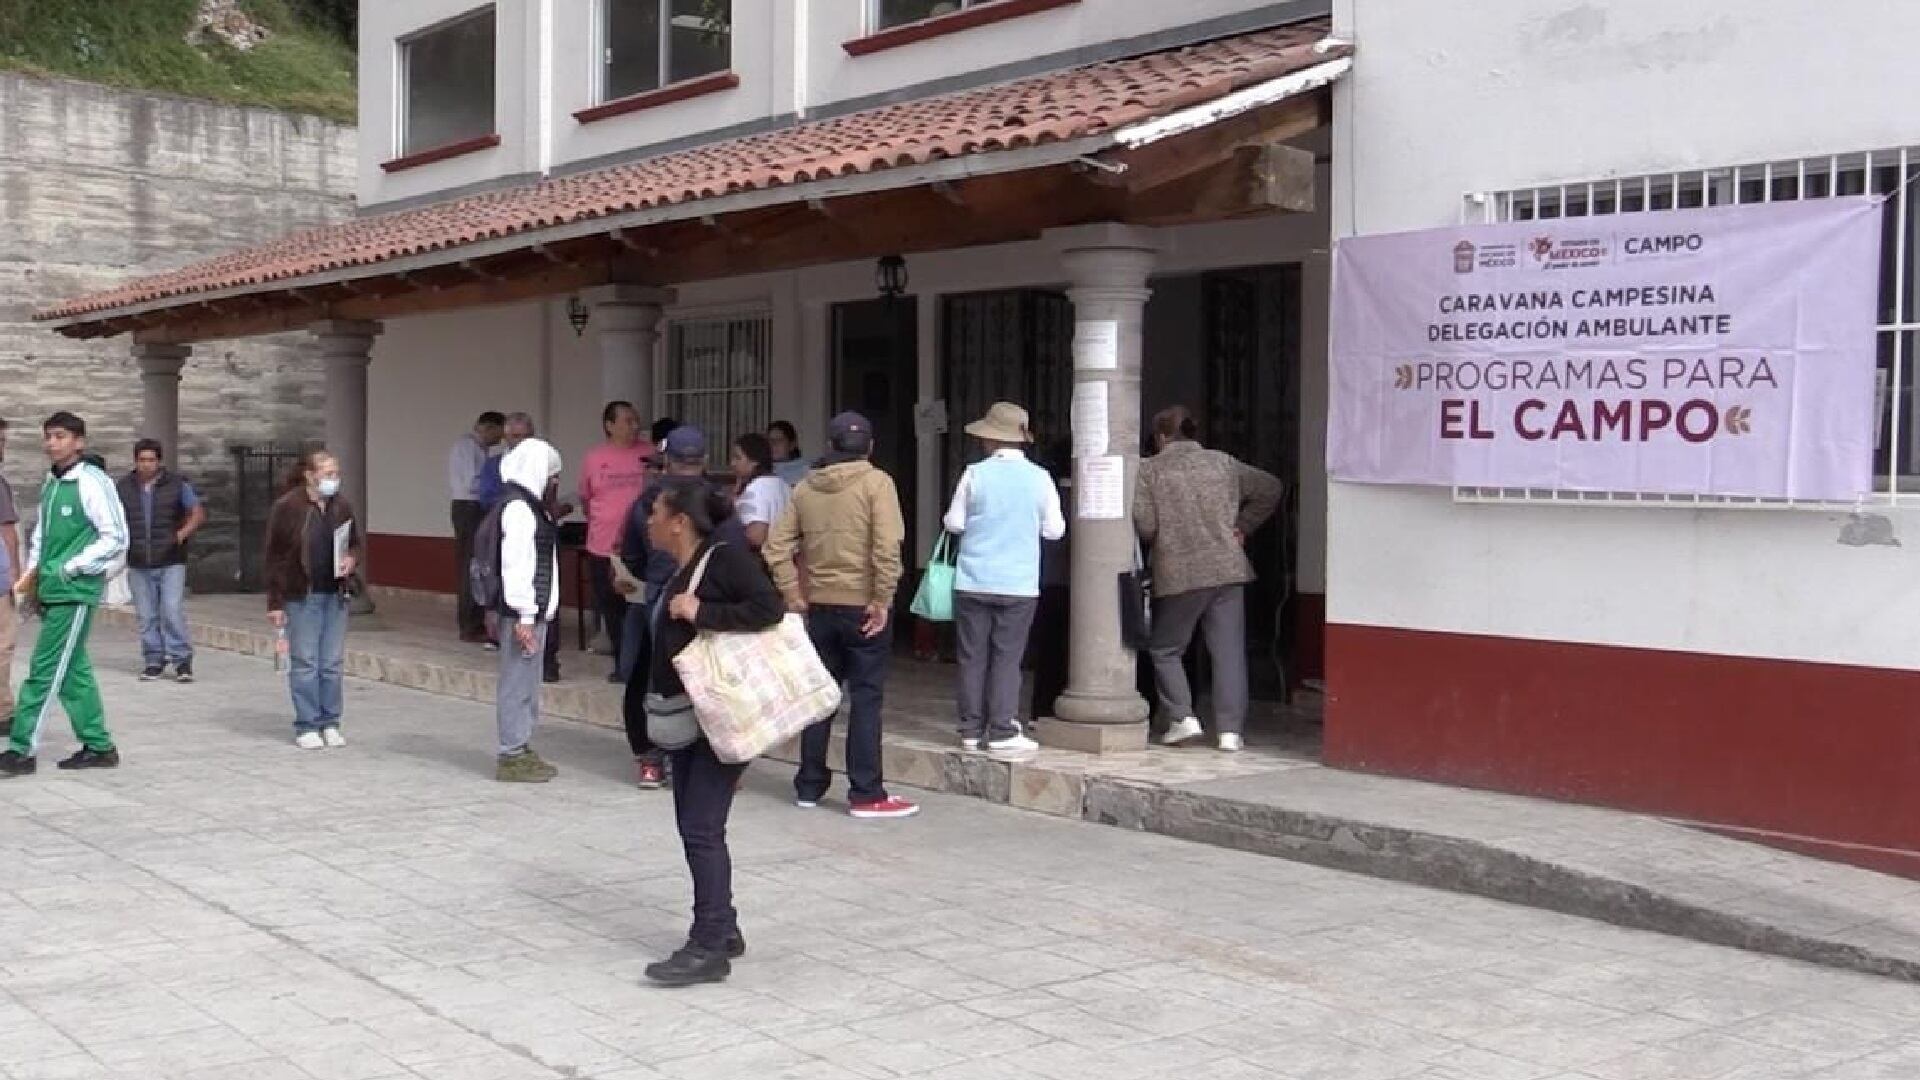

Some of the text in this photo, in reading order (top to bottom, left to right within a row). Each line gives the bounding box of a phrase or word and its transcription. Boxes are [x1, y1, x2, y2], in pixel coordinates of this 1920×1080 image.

[1624, 233, 1704, 256] CAMPO
[1439, 285, 1714, 315] CARAVANA CAMPESINA
[1428, 314, 1731, 342] DELEGACIÓN AMBULANTE
[1416, 356, 1778, 391] PROGRAMAS PARA
[1440, 398, 1720, 443] EL CAMPO
